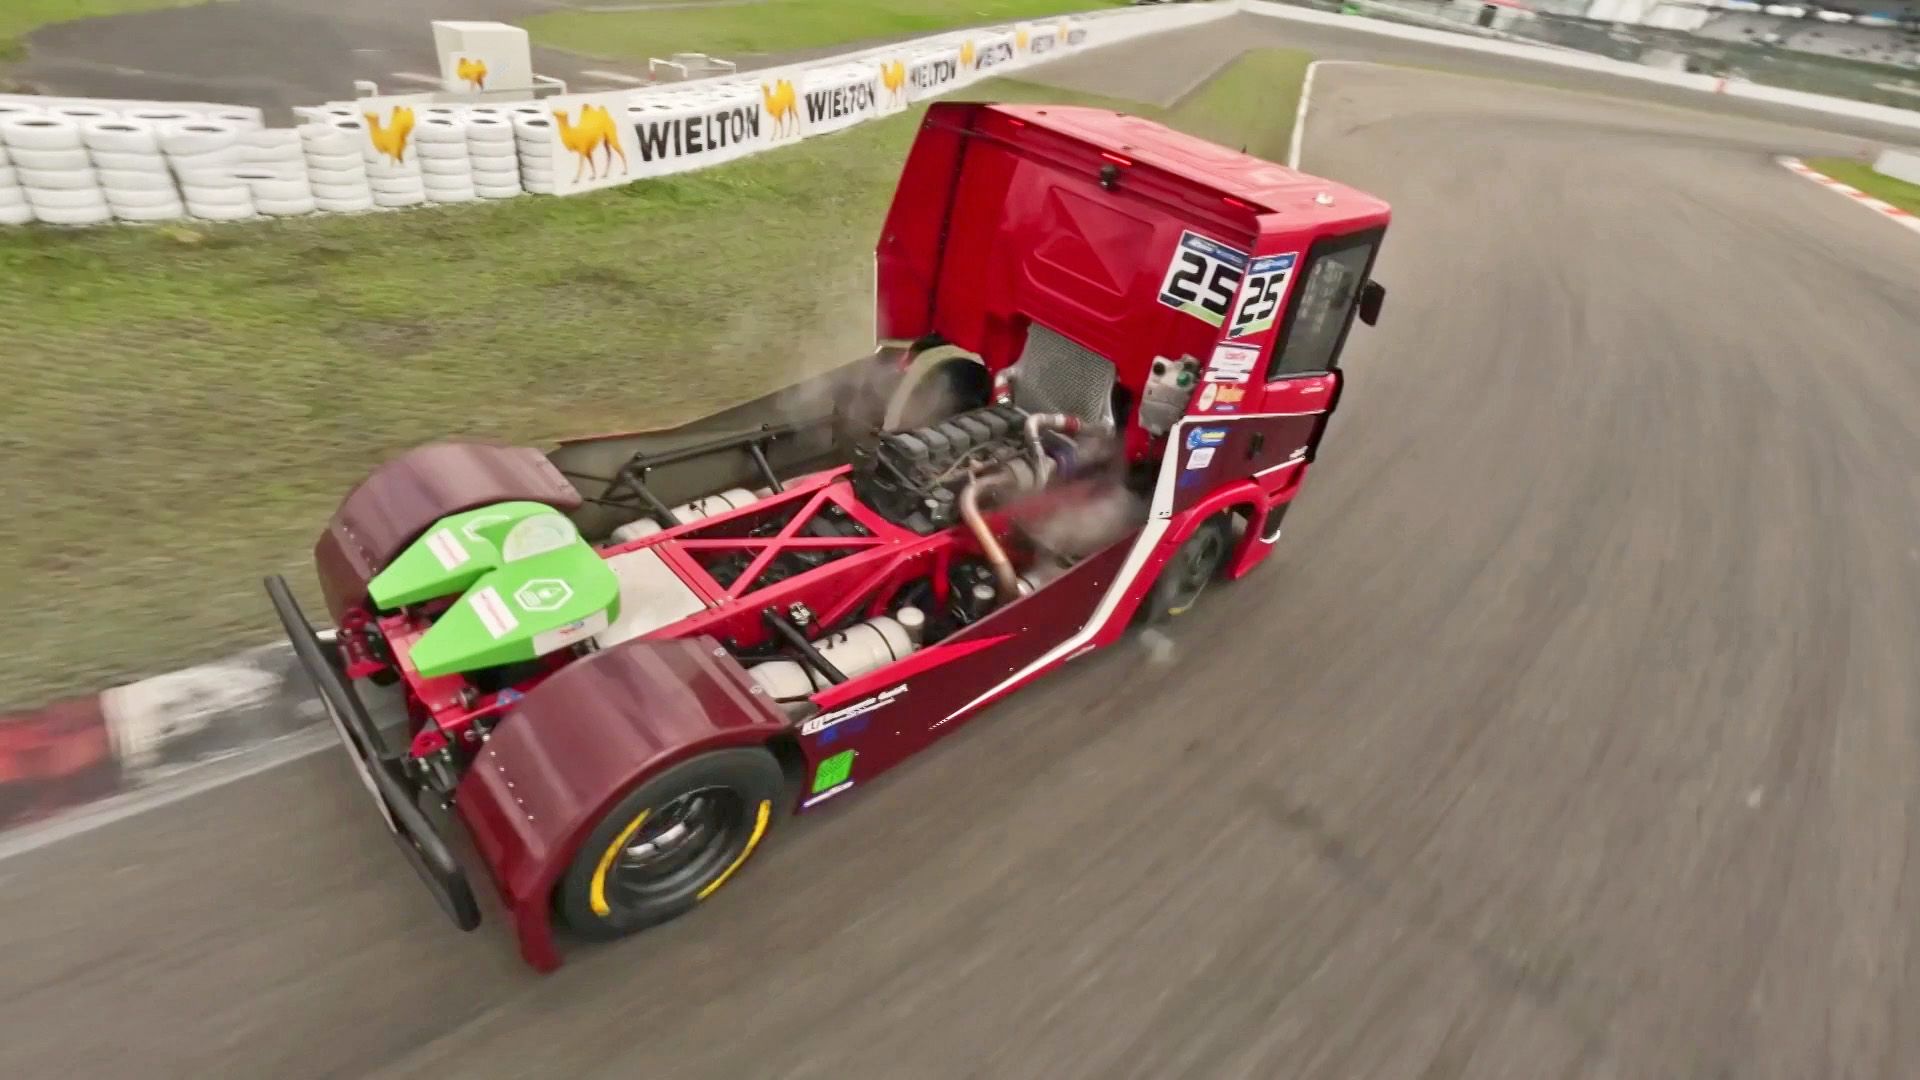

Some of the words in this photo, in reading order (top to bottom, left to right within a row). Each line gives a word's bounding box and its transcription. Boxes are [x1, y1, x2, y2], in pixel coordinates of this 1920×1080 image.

[804, 81, 875, 123] WIELTON
[634, 104, 760, 162] WIELTON
[1167, 251, 1242, 316] 25
[1236, 271, 1286, 326] 25
